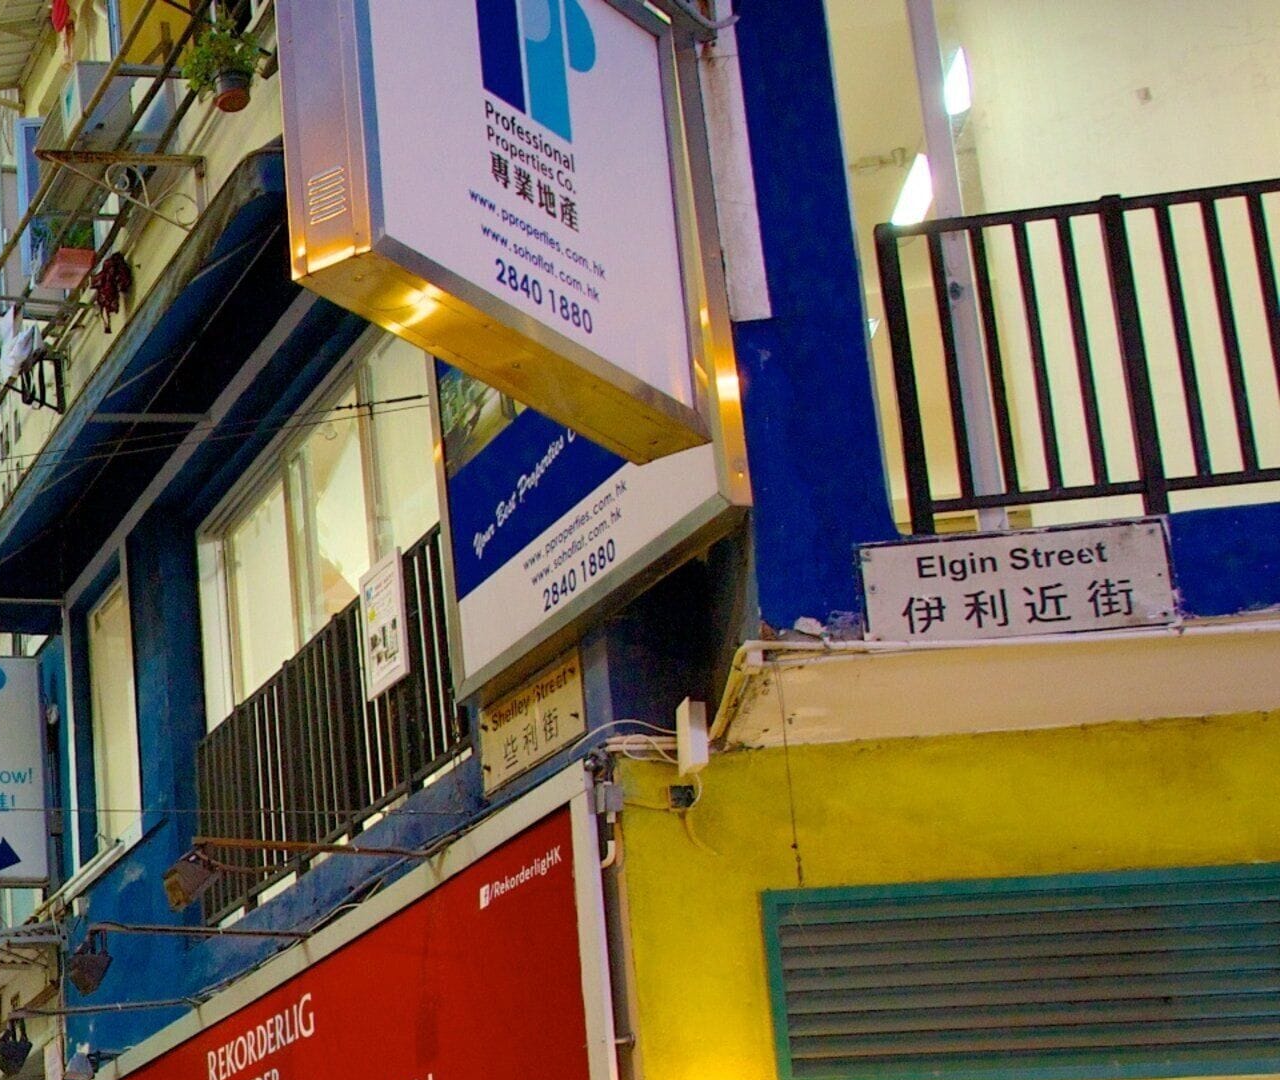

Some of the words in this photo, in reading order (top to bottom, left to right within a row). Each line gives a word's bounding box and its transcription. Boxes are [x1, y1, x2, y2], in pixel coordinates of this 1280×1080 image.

[485, 100, 575, 173] Professional
[487, 124, 554, 181] Properties
[556, 167, 576, 194] Co.
[489, 151, 579, 232] 專業地產
[469, 189, 606, 279] www.pproperties.com.hk
[481, 223, 599, 302] www.sohoflat.com.hk
[495, 258, 543, 305] 2840
[549, 289, 592, 334] 1880
[523, 480, 627, 570] www.pproperties.com.hk
[531, 507, 622, 586] www.sohoflat.com.hk
[915, 552, 998, 582] Elgin
[1009, 542, 1108, 571] Street
[543, 568, 577, 613] 2840
[580, 538, 617, 583] 1880
[902, 578, 1134, 635] 伊利近街
[491, 695, 530, 732] Shelley
[533, 666, 568, 702] Street
